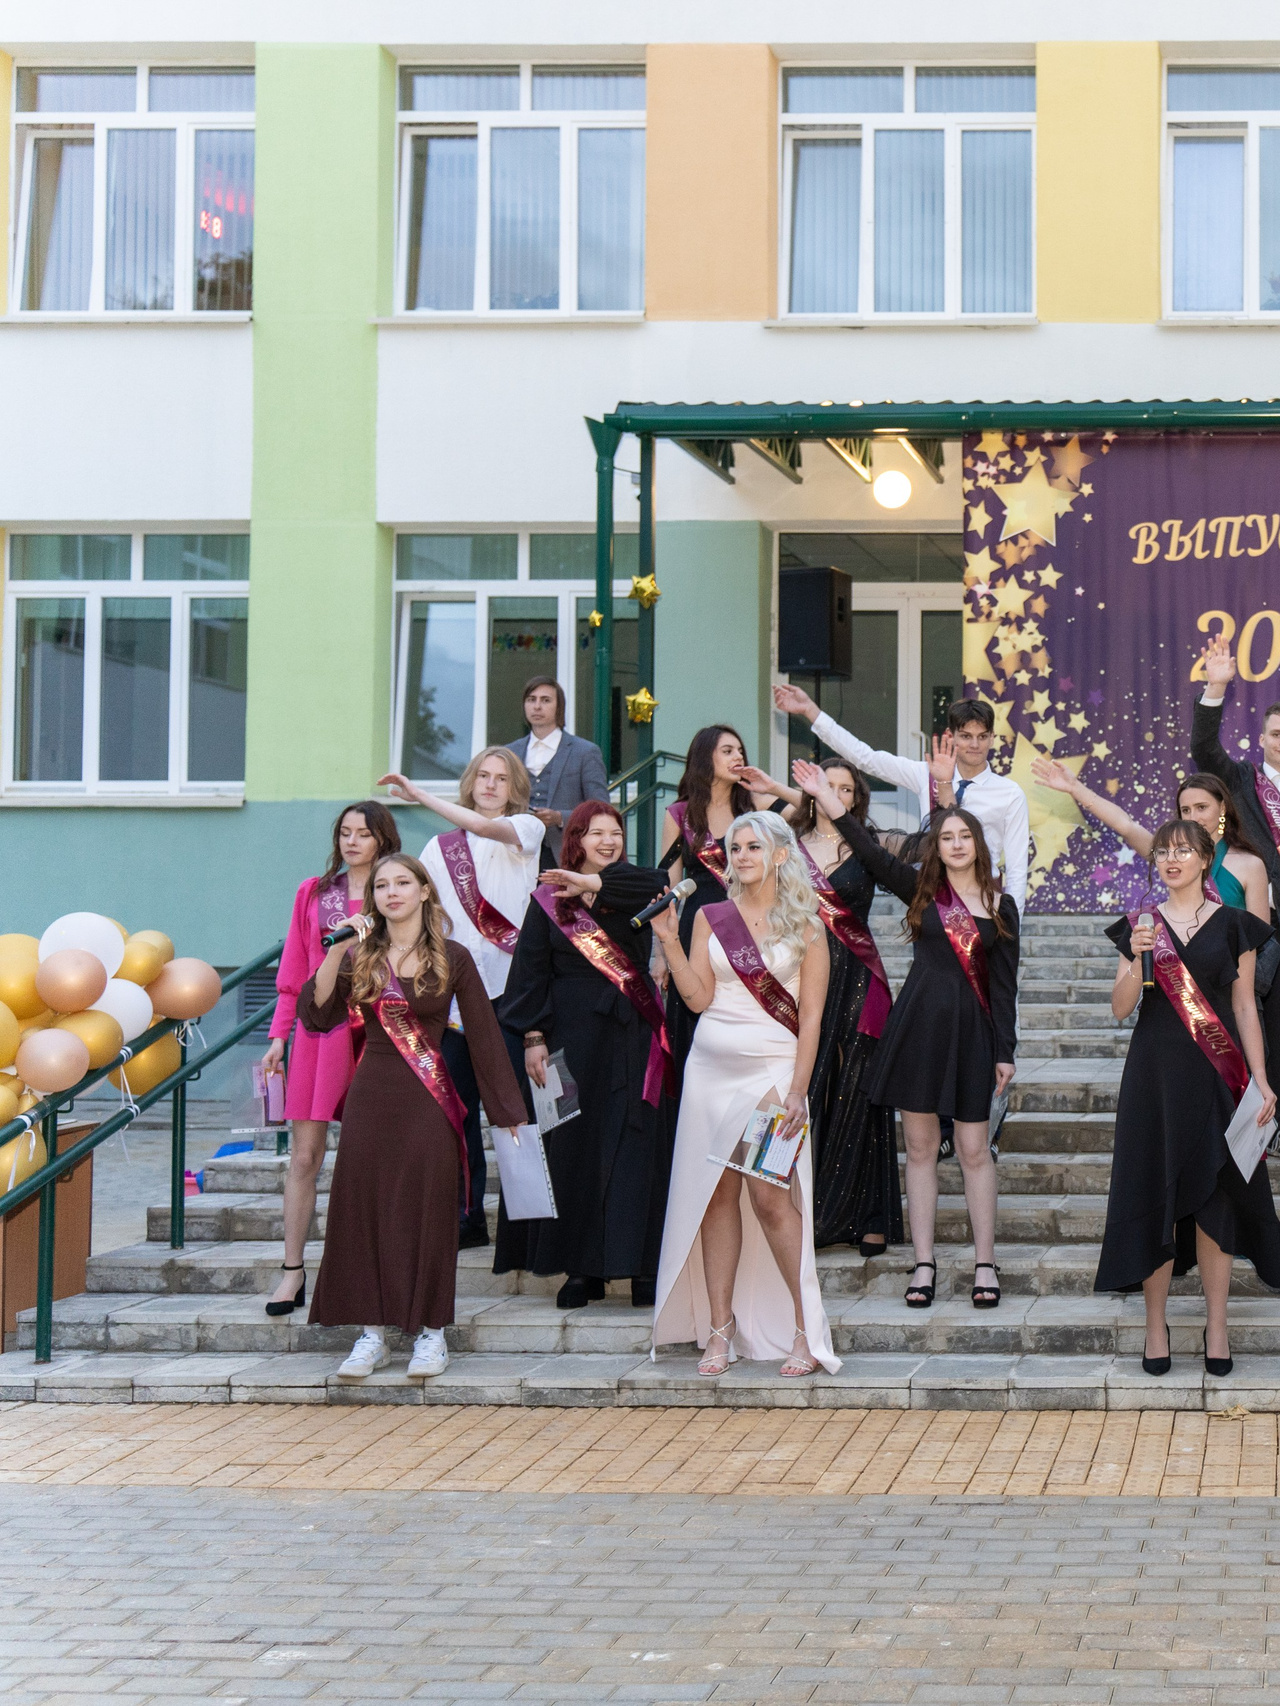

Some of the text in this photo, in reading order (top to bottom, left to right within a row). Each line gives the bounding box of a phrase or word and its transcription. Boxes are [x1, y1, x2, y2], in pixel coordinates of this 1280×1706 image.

[380, 991, 438, 1073] Выпускница
[747, 966, 799, 1023] Выпускни
[1155, 949, 1206, 1028] Выпускница
[1200, 1024, 1233, 1056] 2024
